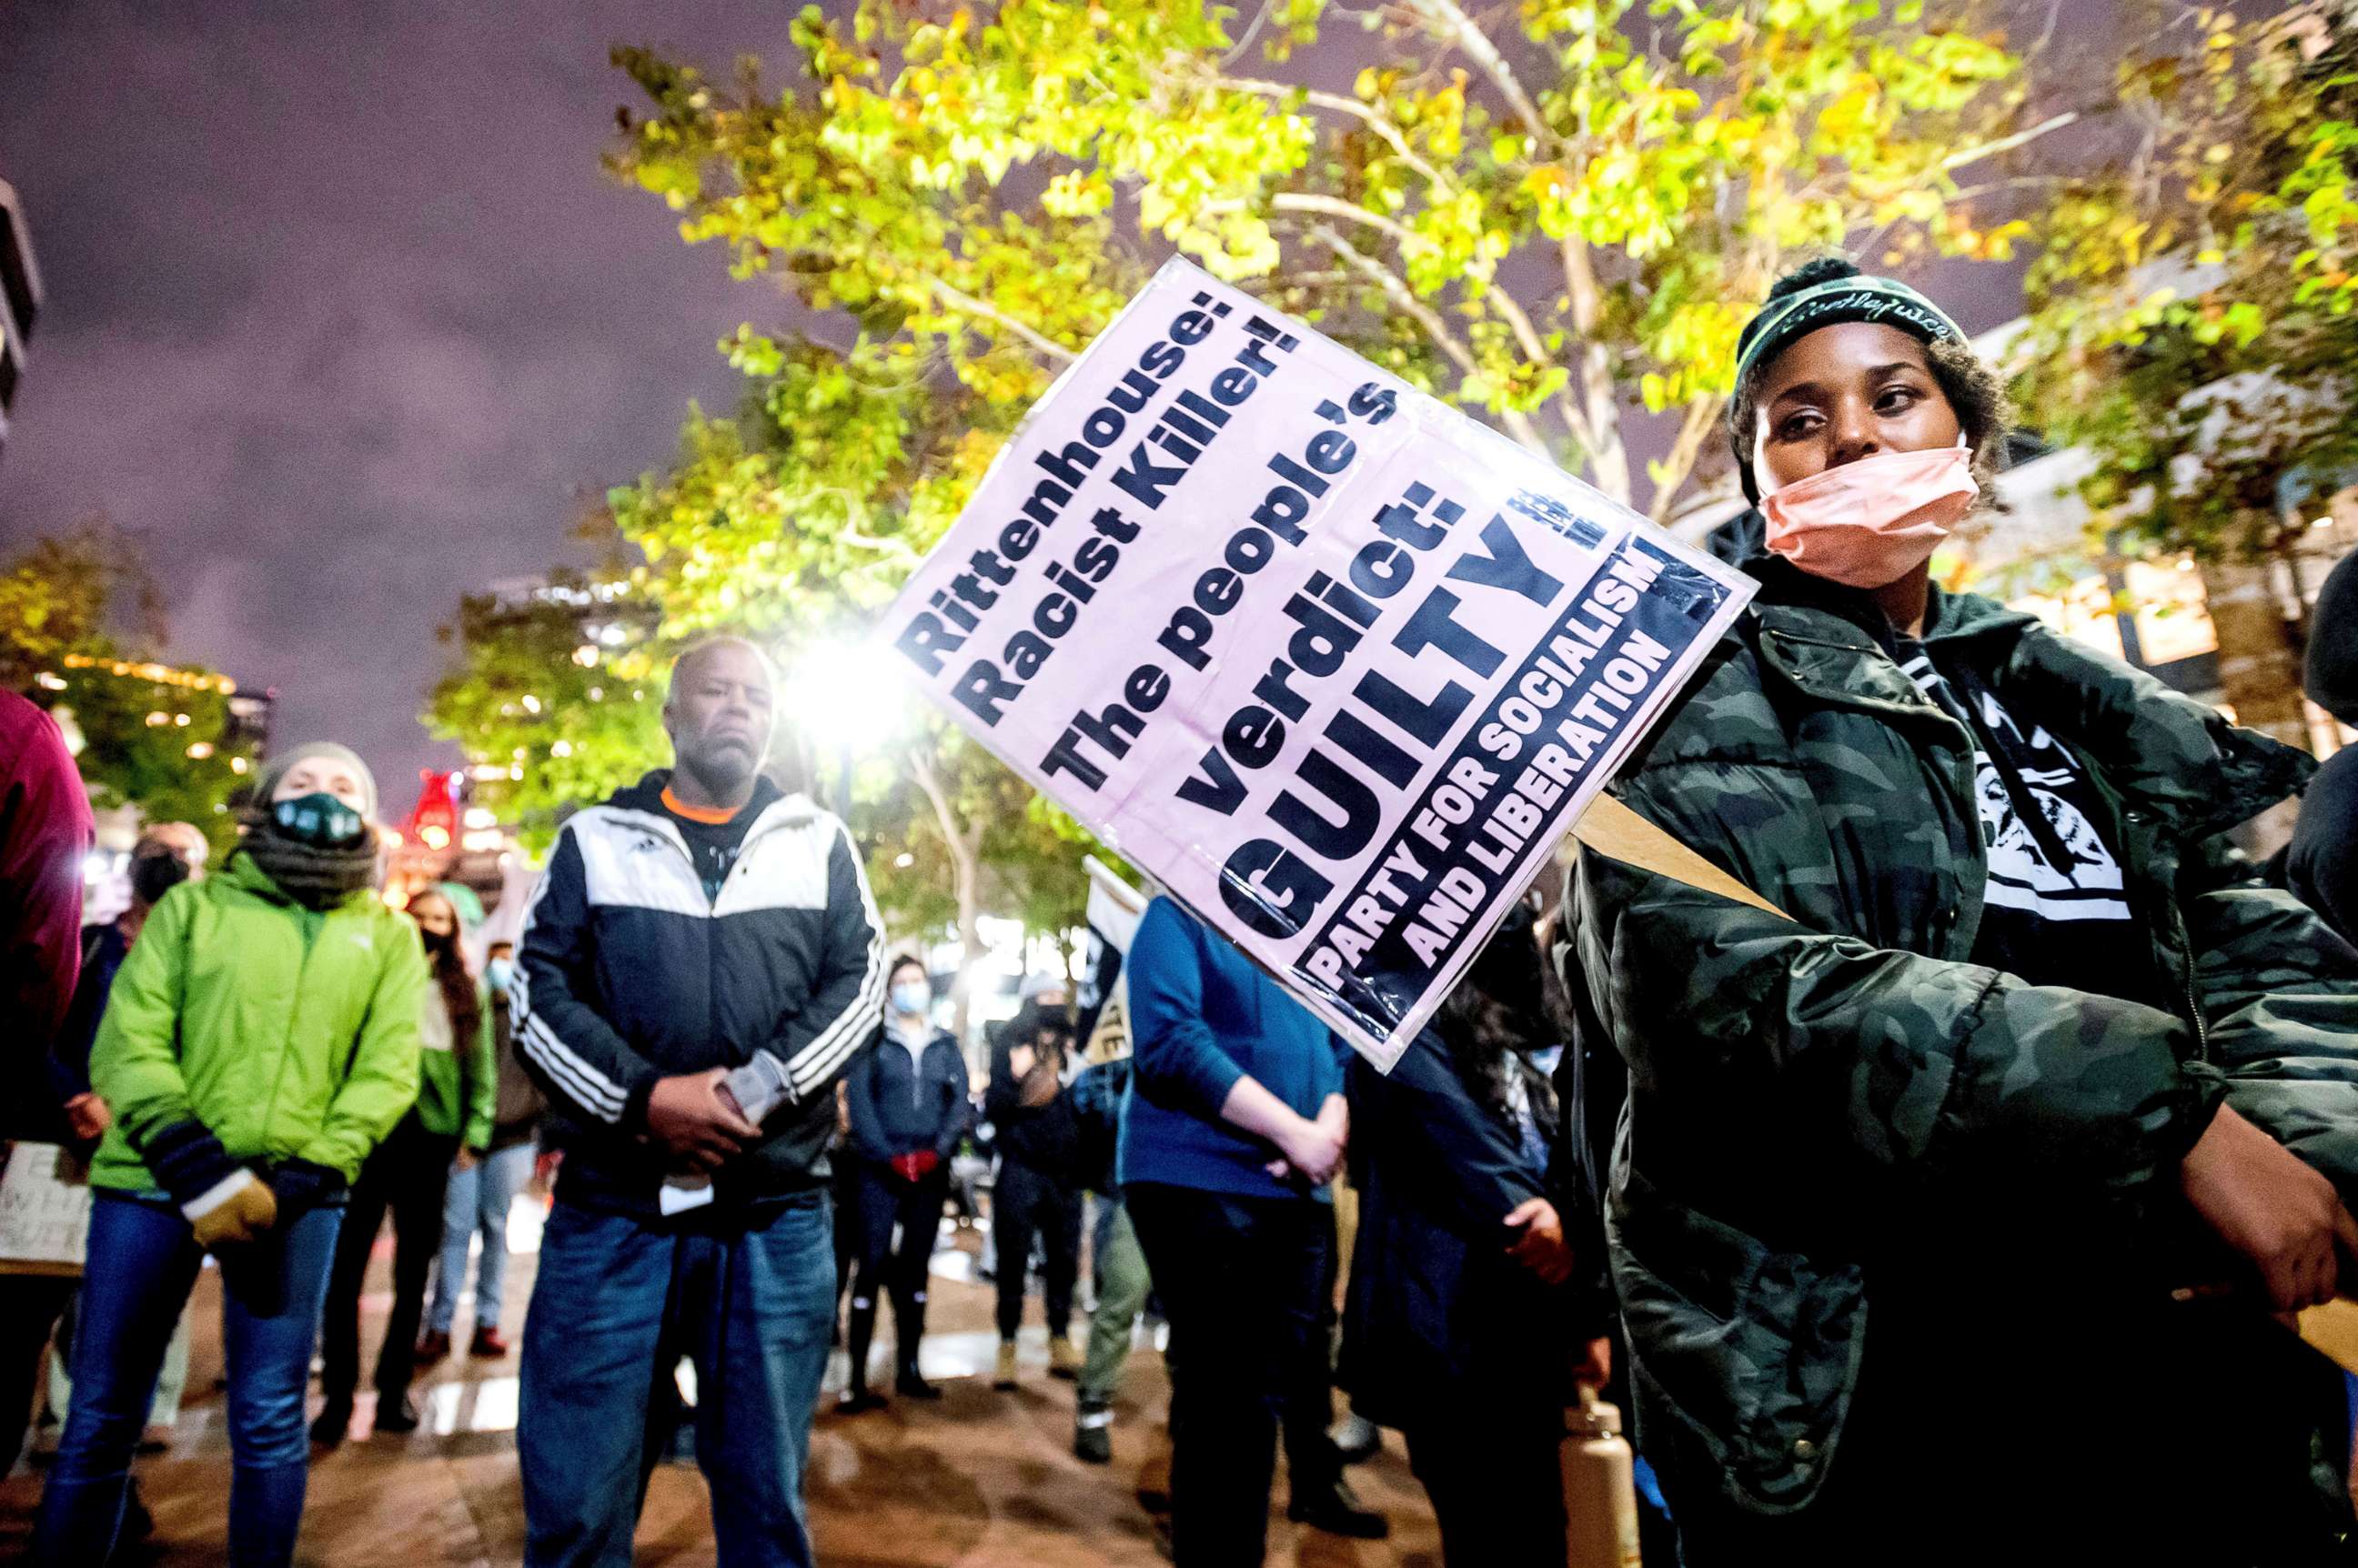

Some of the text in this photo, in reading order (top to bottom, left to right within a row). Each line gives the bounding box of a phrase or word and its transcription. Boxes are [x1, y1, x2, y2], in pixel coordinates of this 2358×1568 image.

[894, 291, 1233, 677] Rittenhouse:
[951, 316, 1301, 728] Racist Killer!
[1039, 382, 1398, 792] The people's
[1175, 480, 1466, 817] verdict:
[1306, 545, 1666, 991] PARTY FOR SOCIALISM
[1402, 629, 1672, 970] AND LIBERATION
